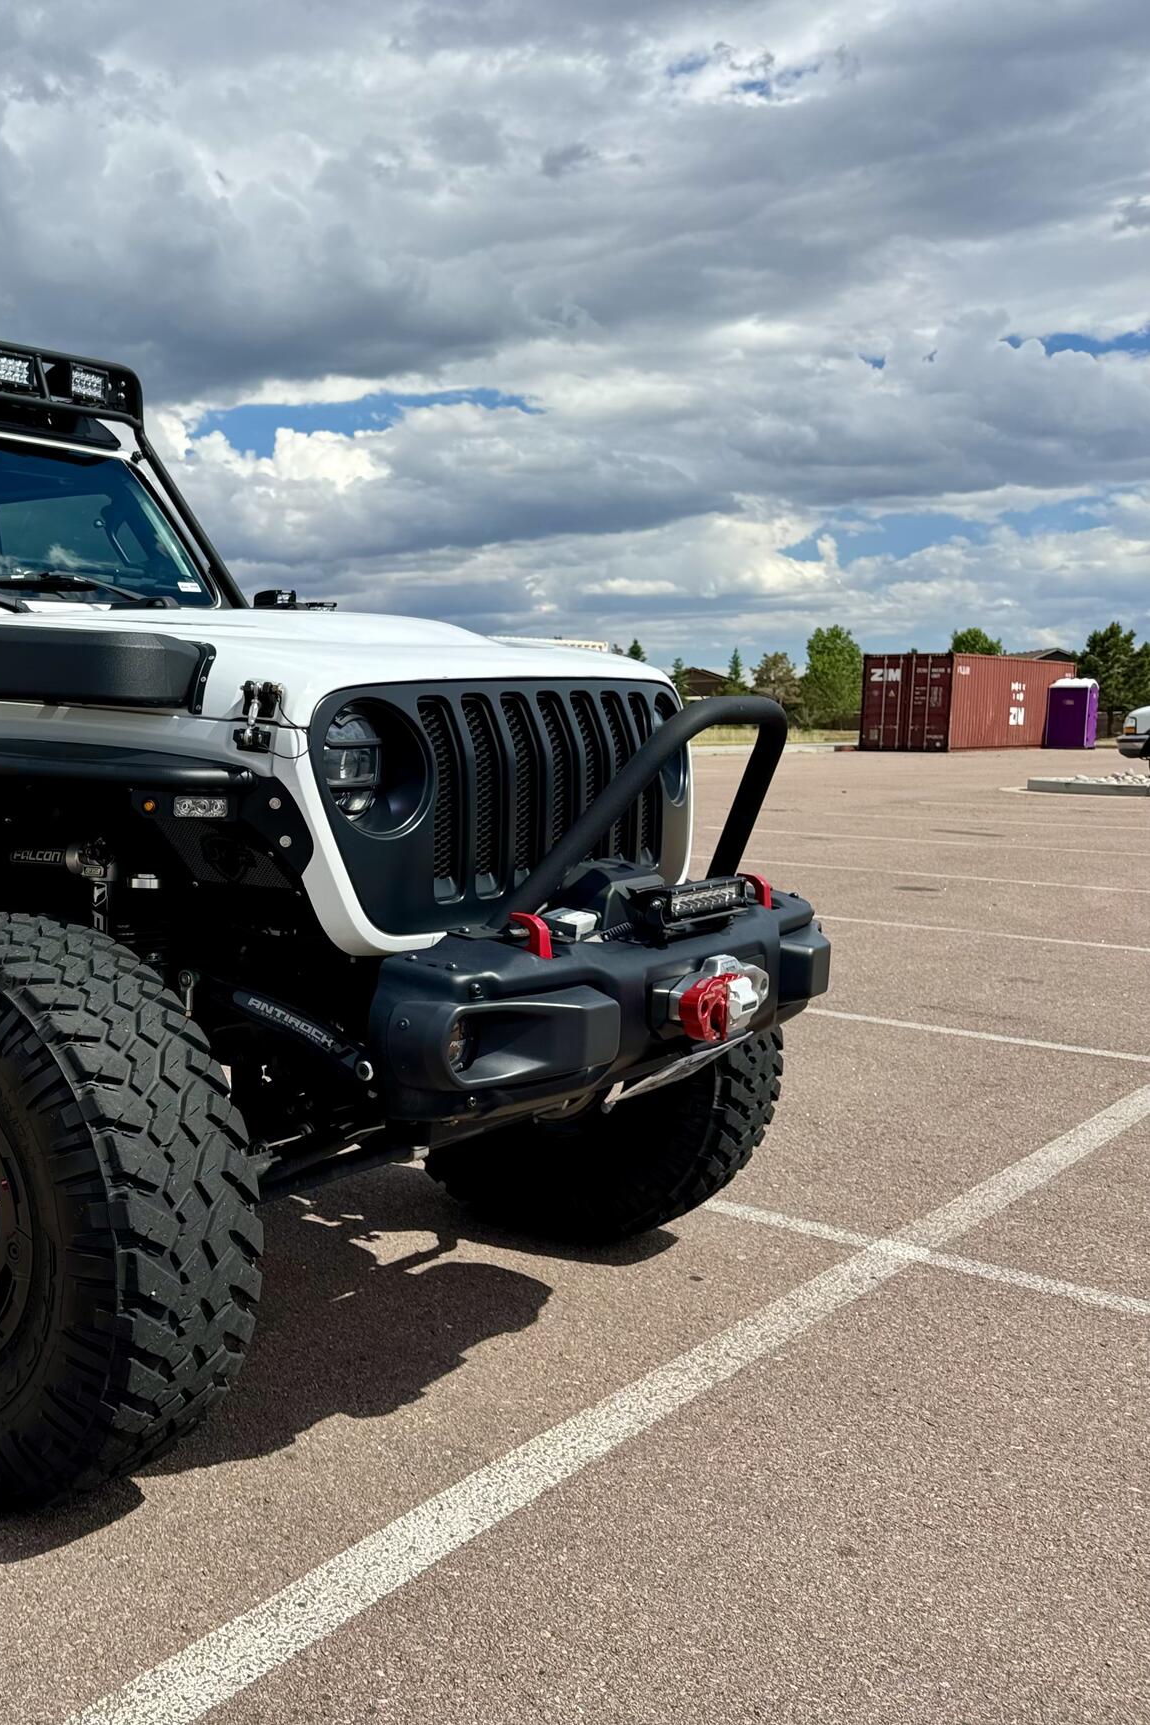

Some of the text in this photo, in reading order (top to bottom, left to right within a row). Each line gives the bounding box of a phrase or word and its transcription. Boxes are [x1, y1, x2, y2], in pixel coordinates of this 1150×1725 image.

[870, 668, 901, 682] ZIM
[13, 850, 63, 862] FALCON
[248, 997, 336, 1048] ANTIROCK
